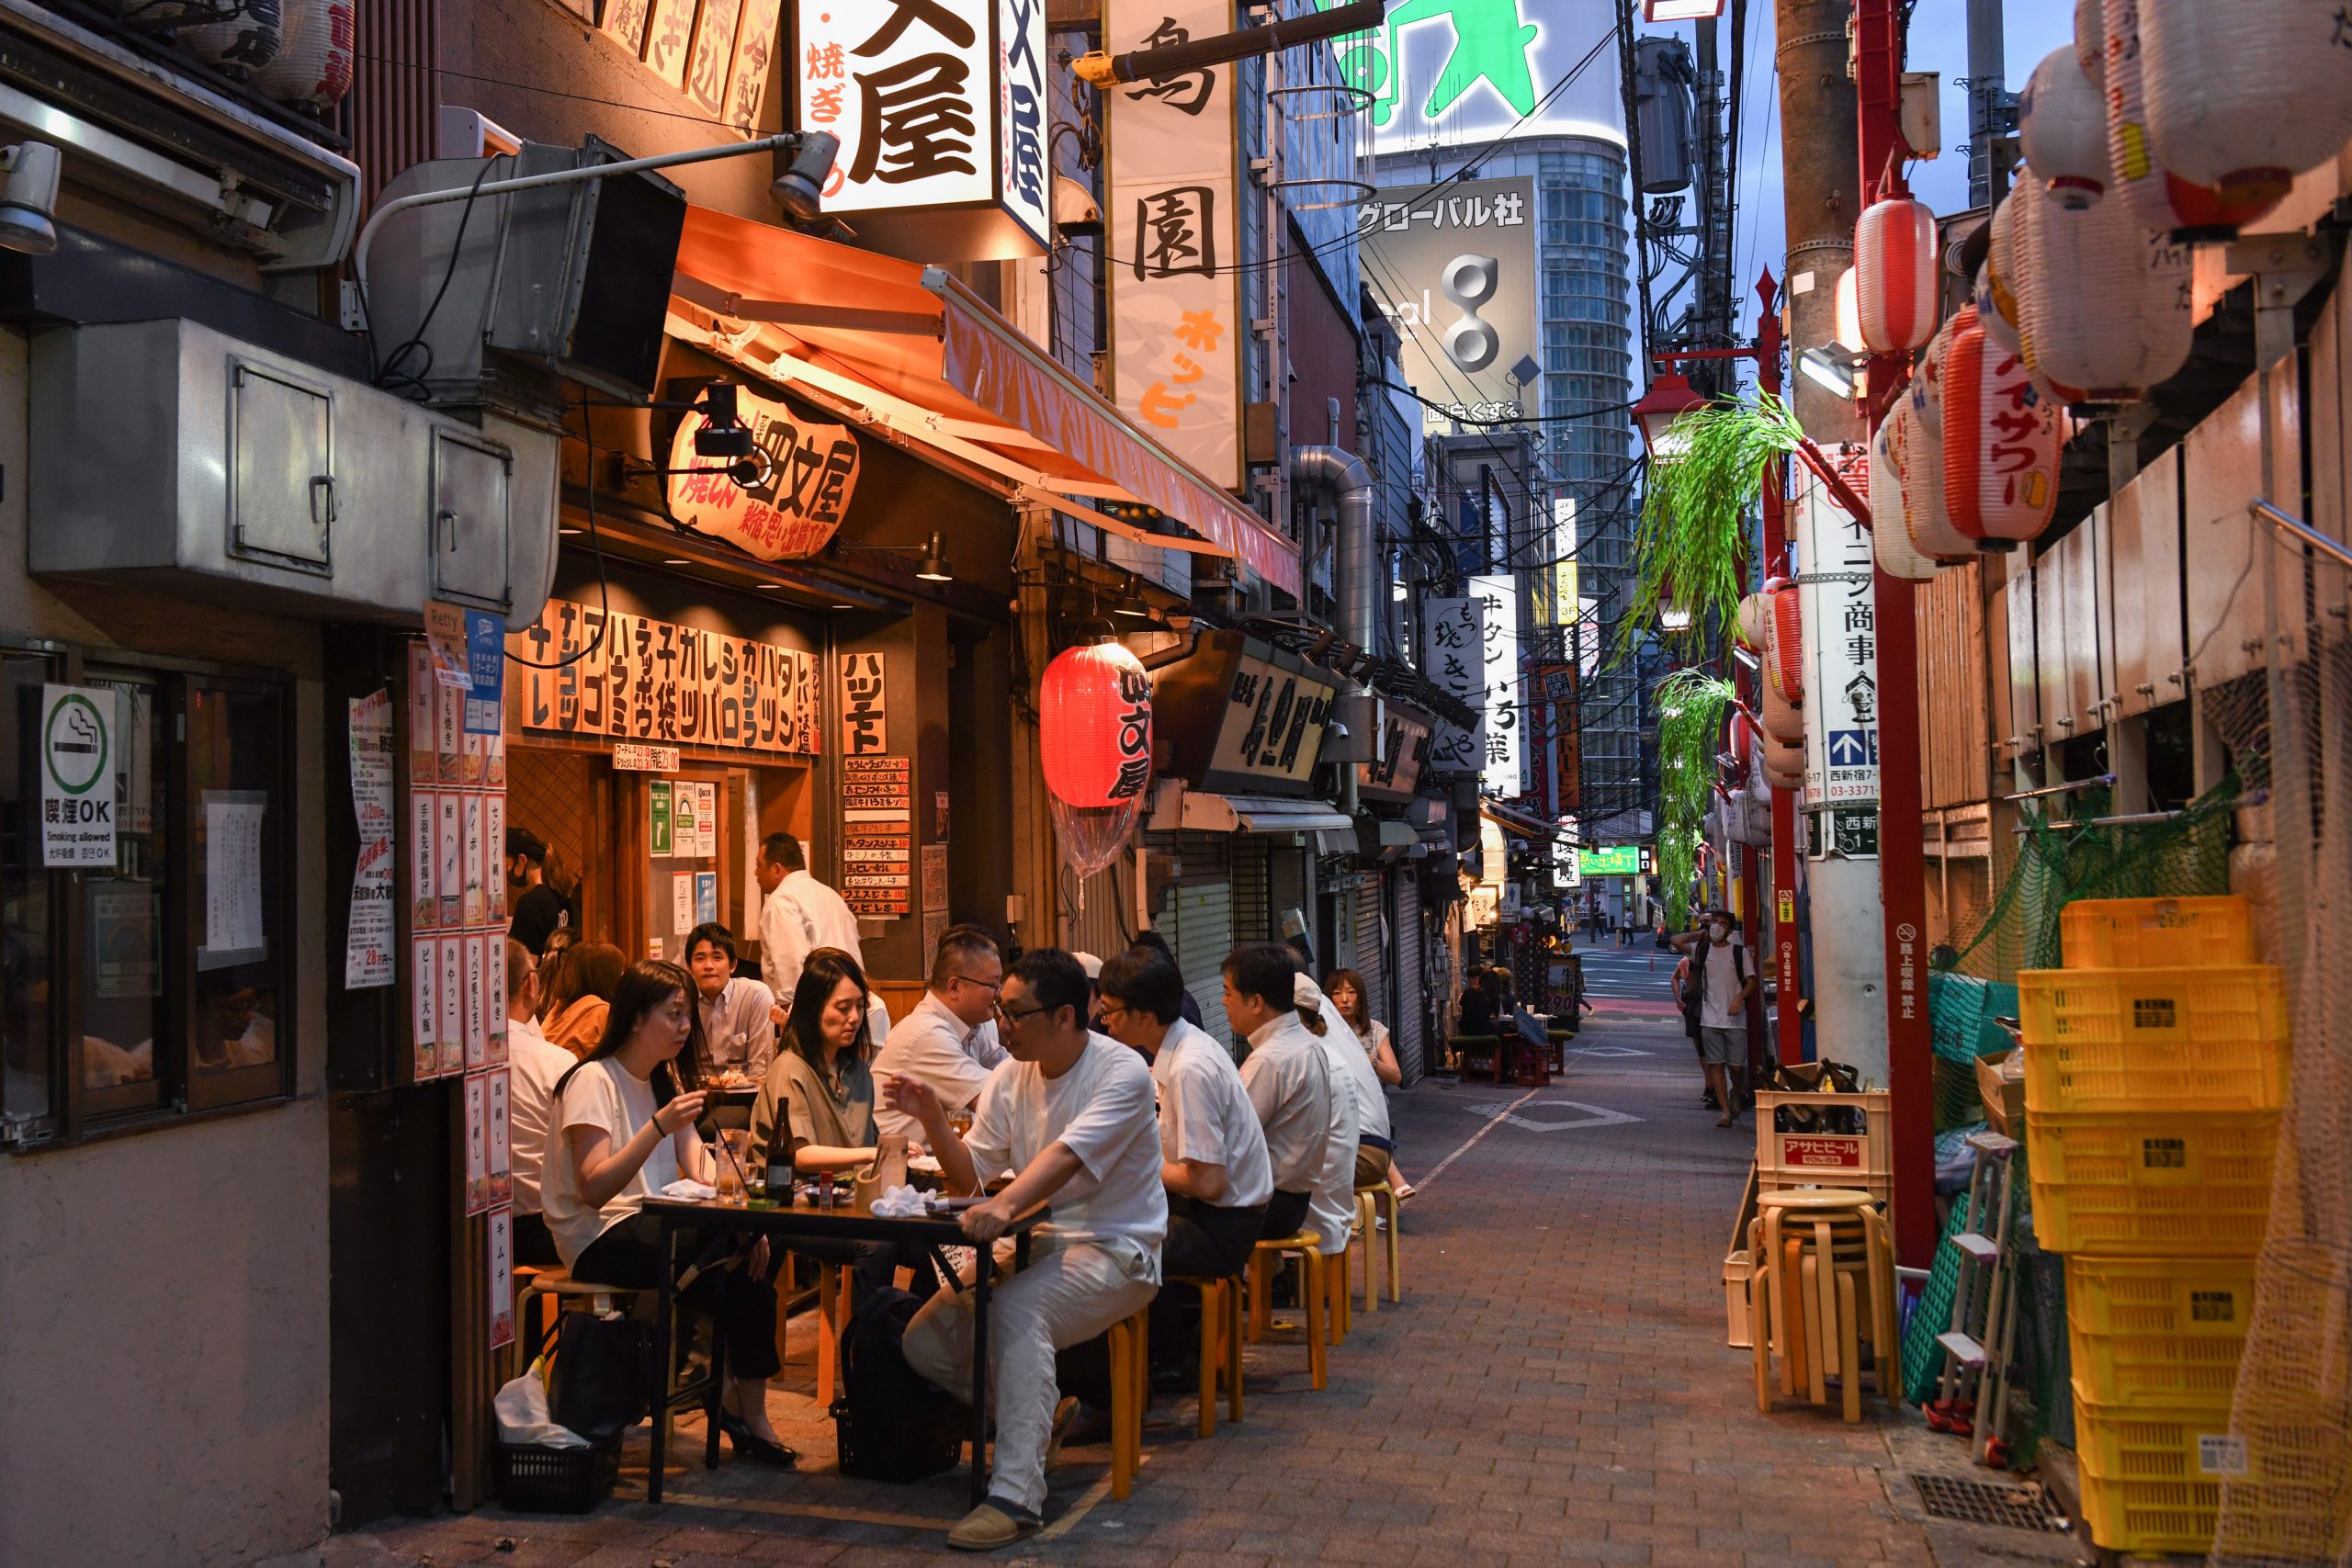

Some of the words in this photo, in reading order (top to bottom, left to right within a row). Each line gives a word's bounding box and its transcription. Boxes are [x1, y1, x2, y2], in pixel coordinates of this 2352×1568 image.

[1358, 192, 1524, 235] グローバル社
[1372, 289, 1430, 325] bal
[431, 609, 458, 634] Retty
[559, 602, 580, 731] ナンコツ
[583, 612, 606, 728] アゴ
[609, 615, 629, 736] ハラミ
[634, 618, 653, 737] テッポウ
[656, 626, 677, 739] 子袋
[680, 628, 698, 738] ガツ
[701, 633, 718, 740] レバ
[721, 642, 739, 739] シロ
[742, 641, 758, 748] カシラ
[760, 645, 775, 743] ハツ
[778, 654, 794, 747] タン
[843, 653, 885, 753] ハツモト
[1440, 653, 1475, 767] きや
[45, 797, 110, 824] 喫煙OK
[47, 831, 77, 842] Smoking
[79, 831, 110, 842] allowed
[420, 803, 429, 895] 手羽先唐揚げ
[445, 805, 454, 872] 酎ハイ
[1846, 817, 1877, 830] 西新
[422, 948, 431, 1033] ビール大瓶
[447, 947, 455, 1016] 冷やっこ
[1900, 942, 1914, 991] 路上喫煙
[1901, 995, 1915, 1019] 禁止
[472, 1089, 481, 1159] ガツ刺し
[1785, 1140, 1858, 1155] アサヒビール
[497, 1222, 505, 1286] キムチ
